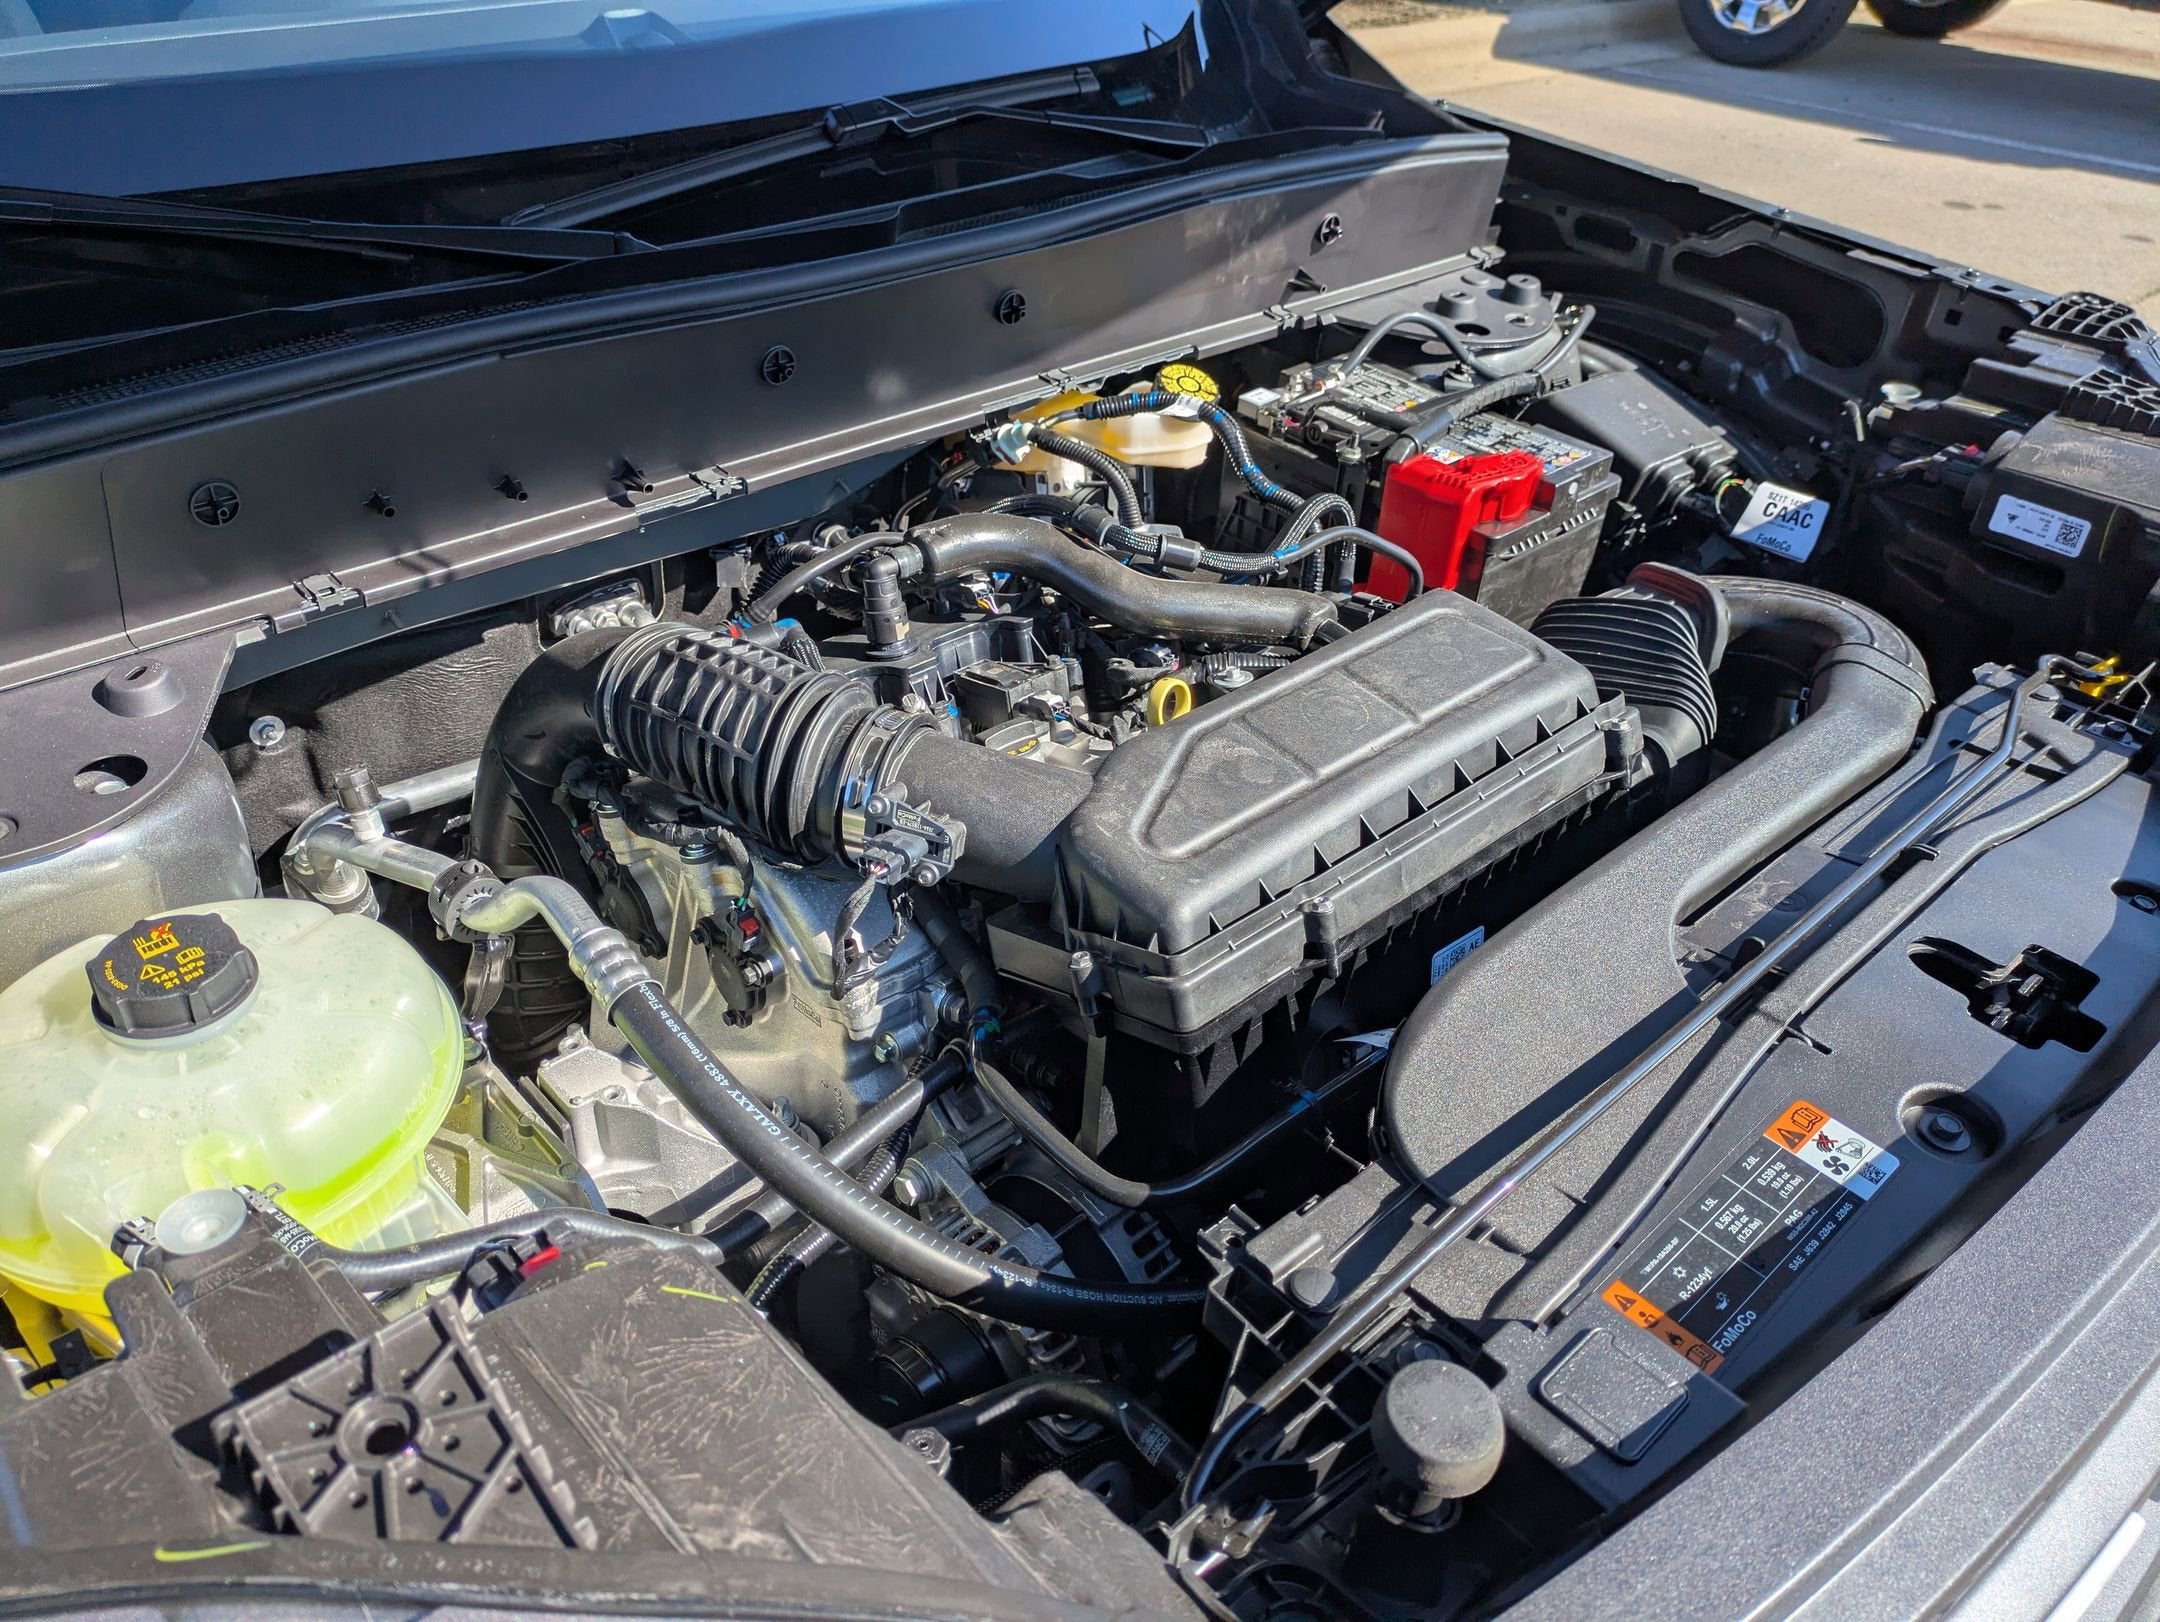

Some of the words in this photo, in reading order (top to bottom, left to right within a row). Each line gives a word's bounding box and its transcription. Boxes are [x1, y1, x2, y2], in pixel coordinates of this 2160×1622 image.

[1762, 501, 1814, 529] CAAC
[1756, 533, 1792, 552] FoMoCo
[179, 960, 206, 974] kPa
[163, 978, 180, 990] 21
[184, 968, 204, 983] psi
[665, 1018, 681, 1033] 5/8
[677, 1032, 708, 1062] (16mm)
[704, 1062, 729, 1087] 4882
[727, 1089, 781, 1136] GALAXY
[1742, 1155, 1760, 1170] 2.0L
[1757, 1168, 1776, 1186] 0.539
[1771, 1161, 1786, 1172] kg
[1782, 1172, 1791, 1180] oz
[1790, 1174, 1804, 1187] lbs)
[1700, 1198, 1718, 1212] 1.5L
[1714, 1211, 1734, 1229] 0.567
[1729, 1204, 1745, 1214] kg
[1728, 1220, 1742, 1234] 20.0
[1740, 1214, 1749, 1224] oz
[1784, 1209, 1803, 1226] PAG
[1737, 1227, 1752, 1243] (1.25
[1748, 1218, 1763, 1231] lbs)
[1788, 1256, 1805, 1272] SAE
[1803, 1239, 1820, 1256] J639
[1818, 1221, 1837, 1240] J2842
[1834, 1202, 1853, 1221] J2845
[1678, 1265, 1713, 1300] R-1234yf
[1076, 1289, 1104, 1301] HOSE
[1105, 1292, 1146, 1305] SUCTION
[1712, 1310, 1757, 1354] FoMoCo
